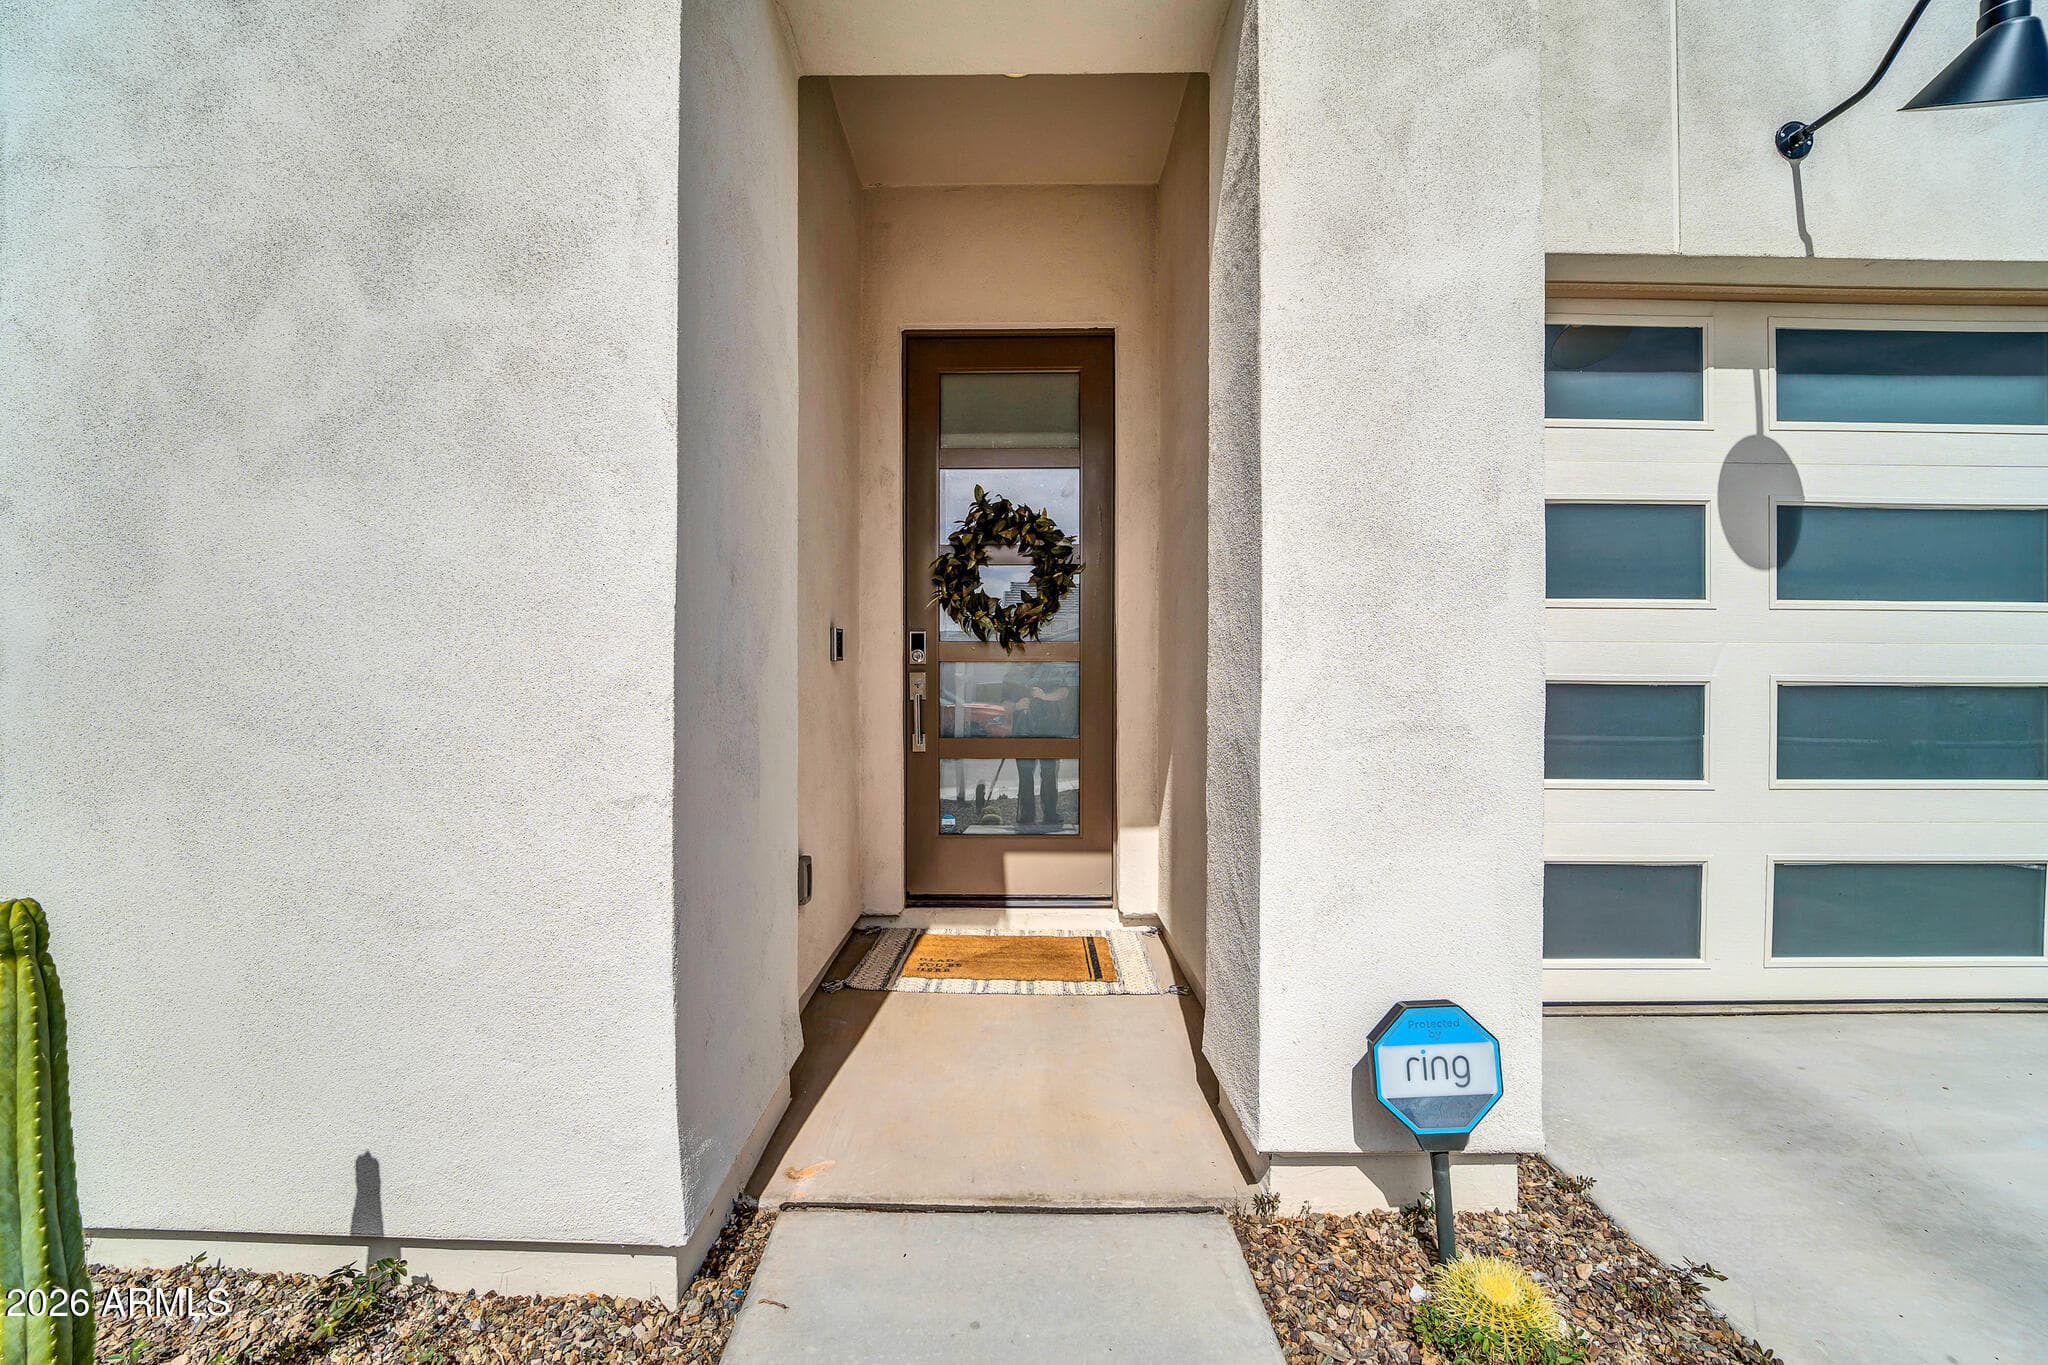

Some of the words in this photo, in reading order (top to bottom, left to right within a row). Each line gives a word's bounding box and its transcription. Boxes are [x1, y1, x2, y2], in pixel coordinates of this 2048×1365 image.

[1407, 1018, 1461, 1030] Protected
[1427, 1029, 1442, 1040] by
[1406, 1049, 1471, 1088] ring
